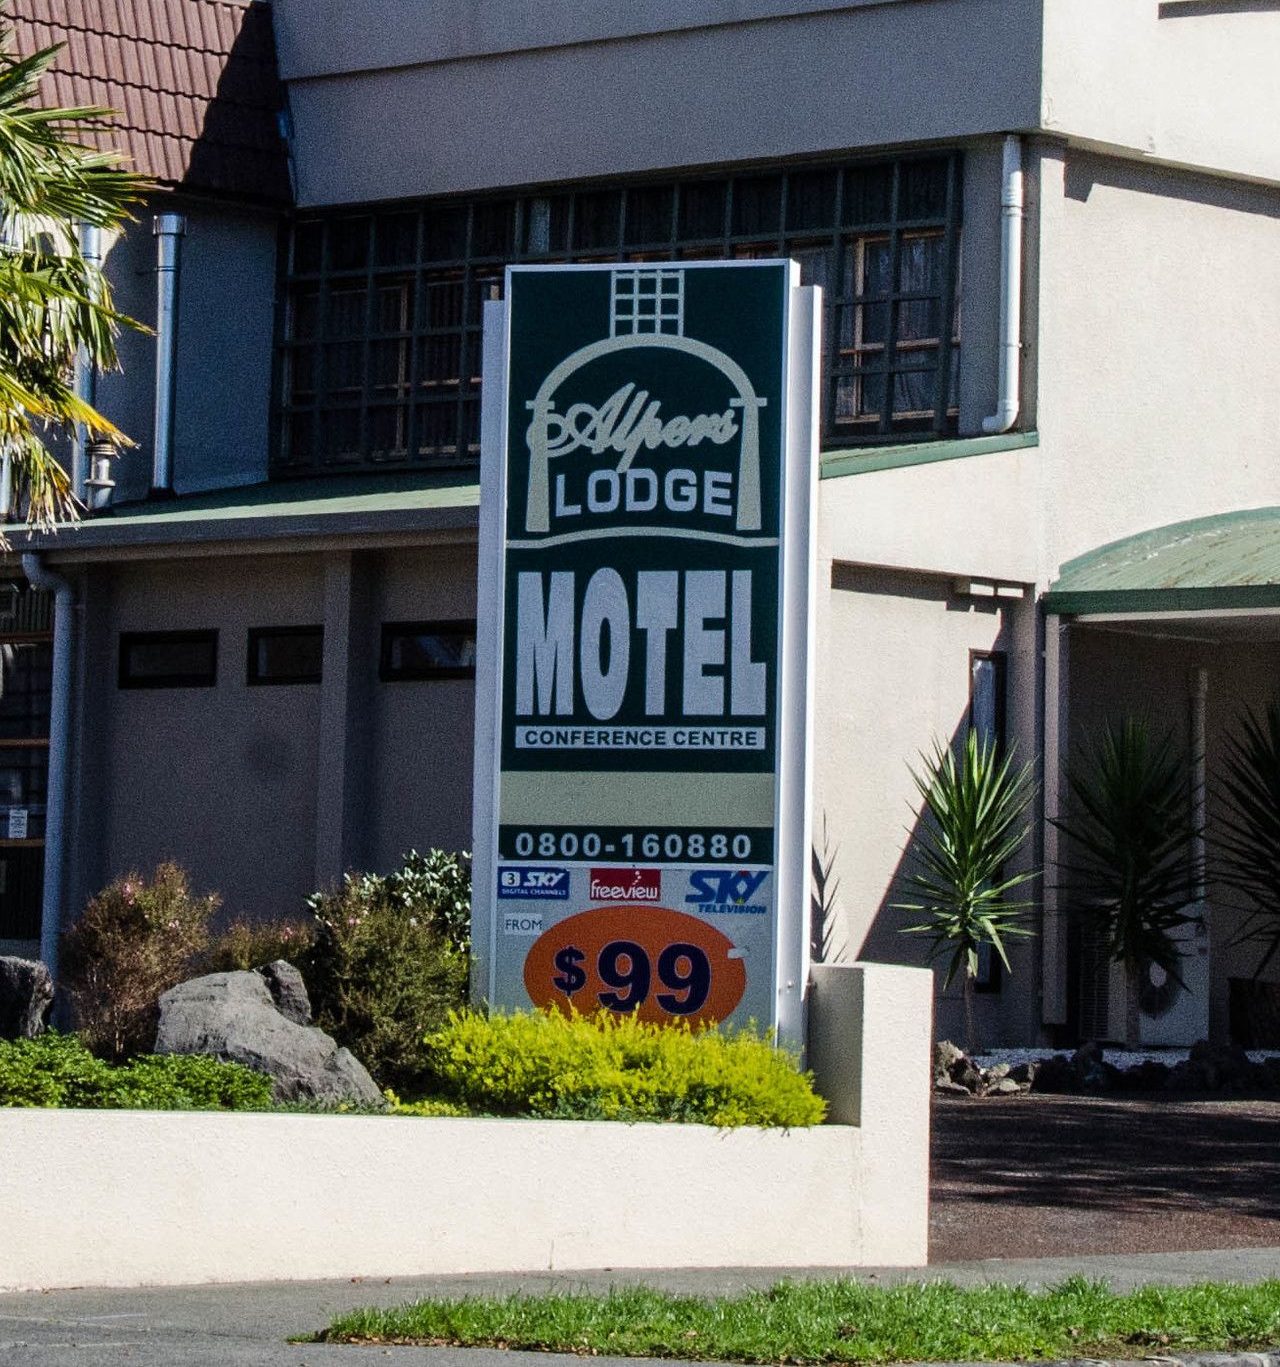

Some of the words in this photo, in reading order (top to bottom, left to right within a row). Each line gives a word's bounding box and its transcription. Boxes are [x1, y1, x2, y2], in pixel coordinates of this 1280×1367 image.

[526, 383, 738, 473] Alpers
[555, 469, 732, 517] LODGE
[516, 567, 767, 721] MOTEL
[524, 730, 666, 747] CONFERENCE
[673, 730, 758, 746] CENTRE
[515, 833, 752, 859] 0800-160880
[523, 871, 565, 887] SKY
[591, 877, 659, 899] freeview
[685, 870, 769, 905] SKY
[699, 904, 767, 914] TELEVISION
[505, 918, 543, 931] FROM
[553, 940, 712, 1015] $99
